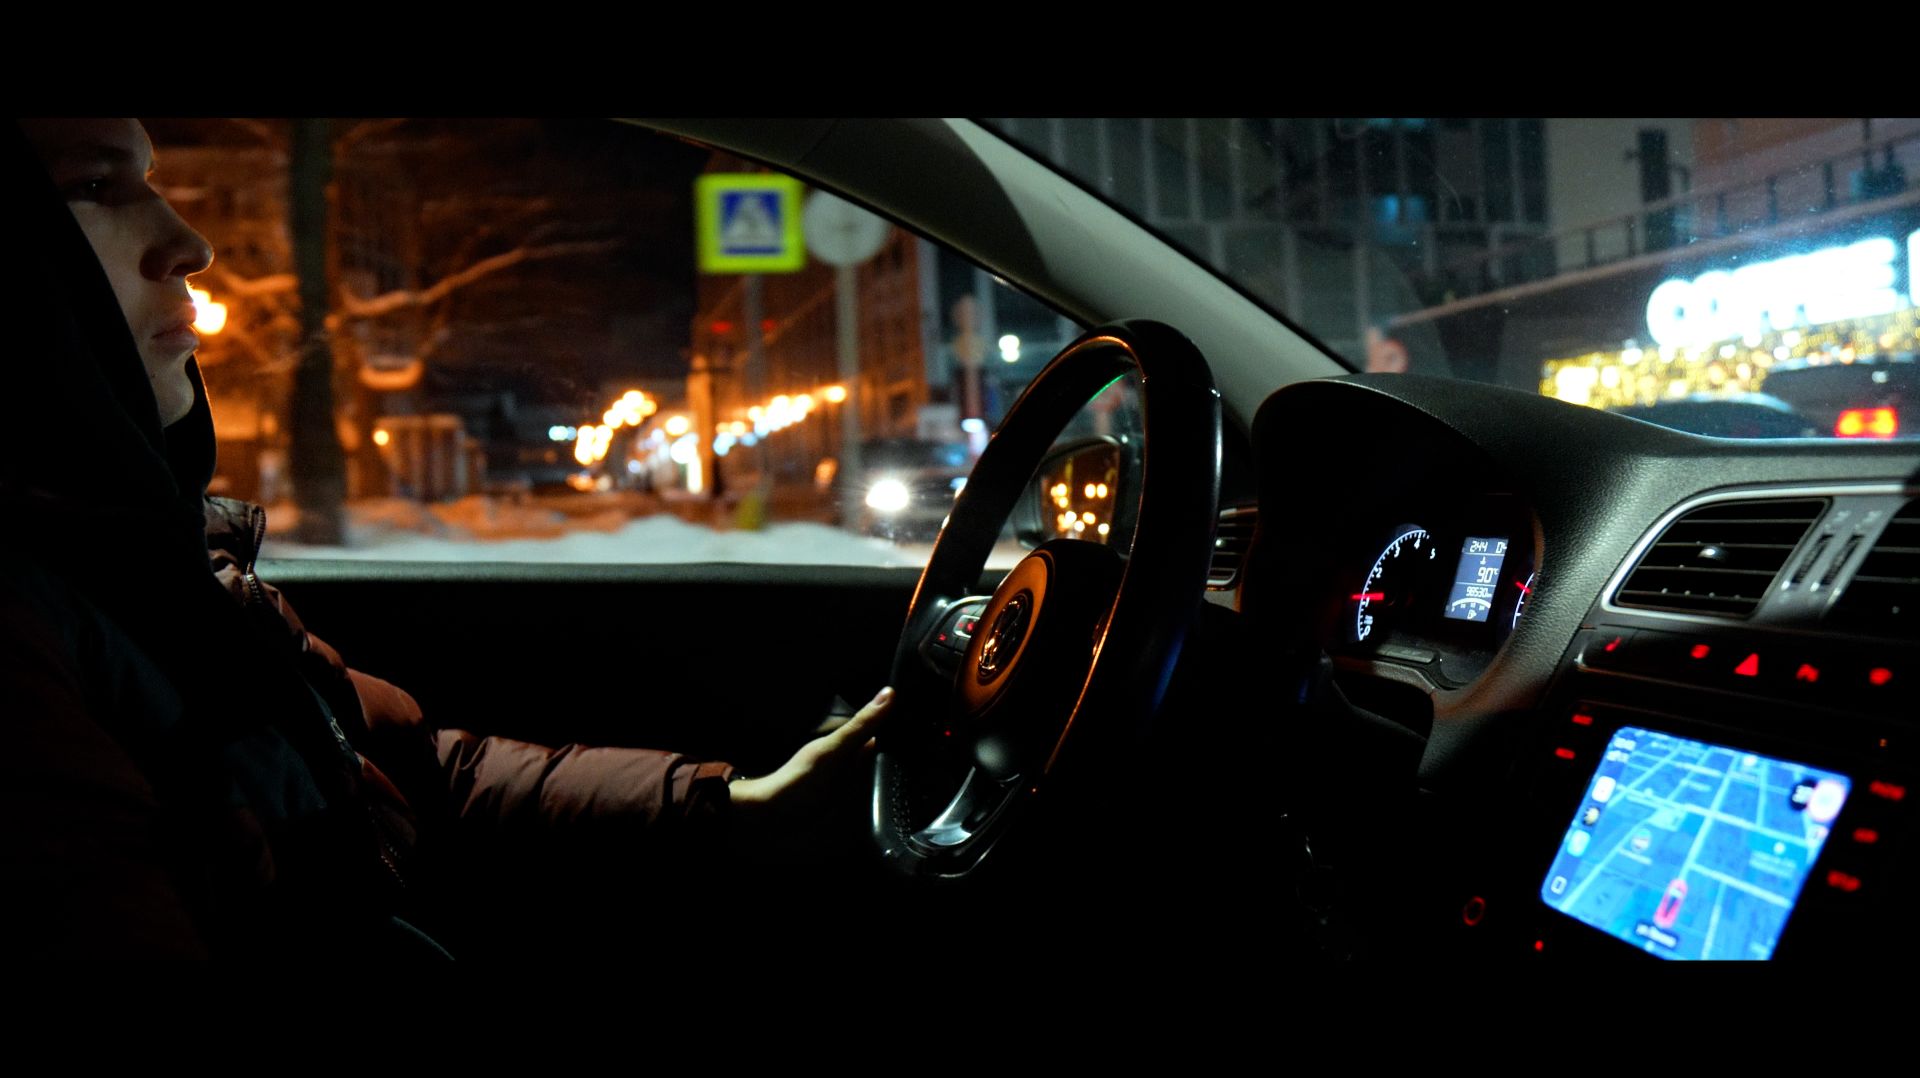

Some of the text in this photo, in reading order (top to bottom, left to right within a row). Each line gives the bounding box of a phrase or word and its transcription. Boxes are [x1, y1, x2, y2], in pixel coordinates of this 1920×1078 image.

[1414, 539, 1421, 550] 4
[1394, 547, 1401, 558] 3
[1430, 548, 1436, 560] 5
[1376, 567, 1383, 579] 2
